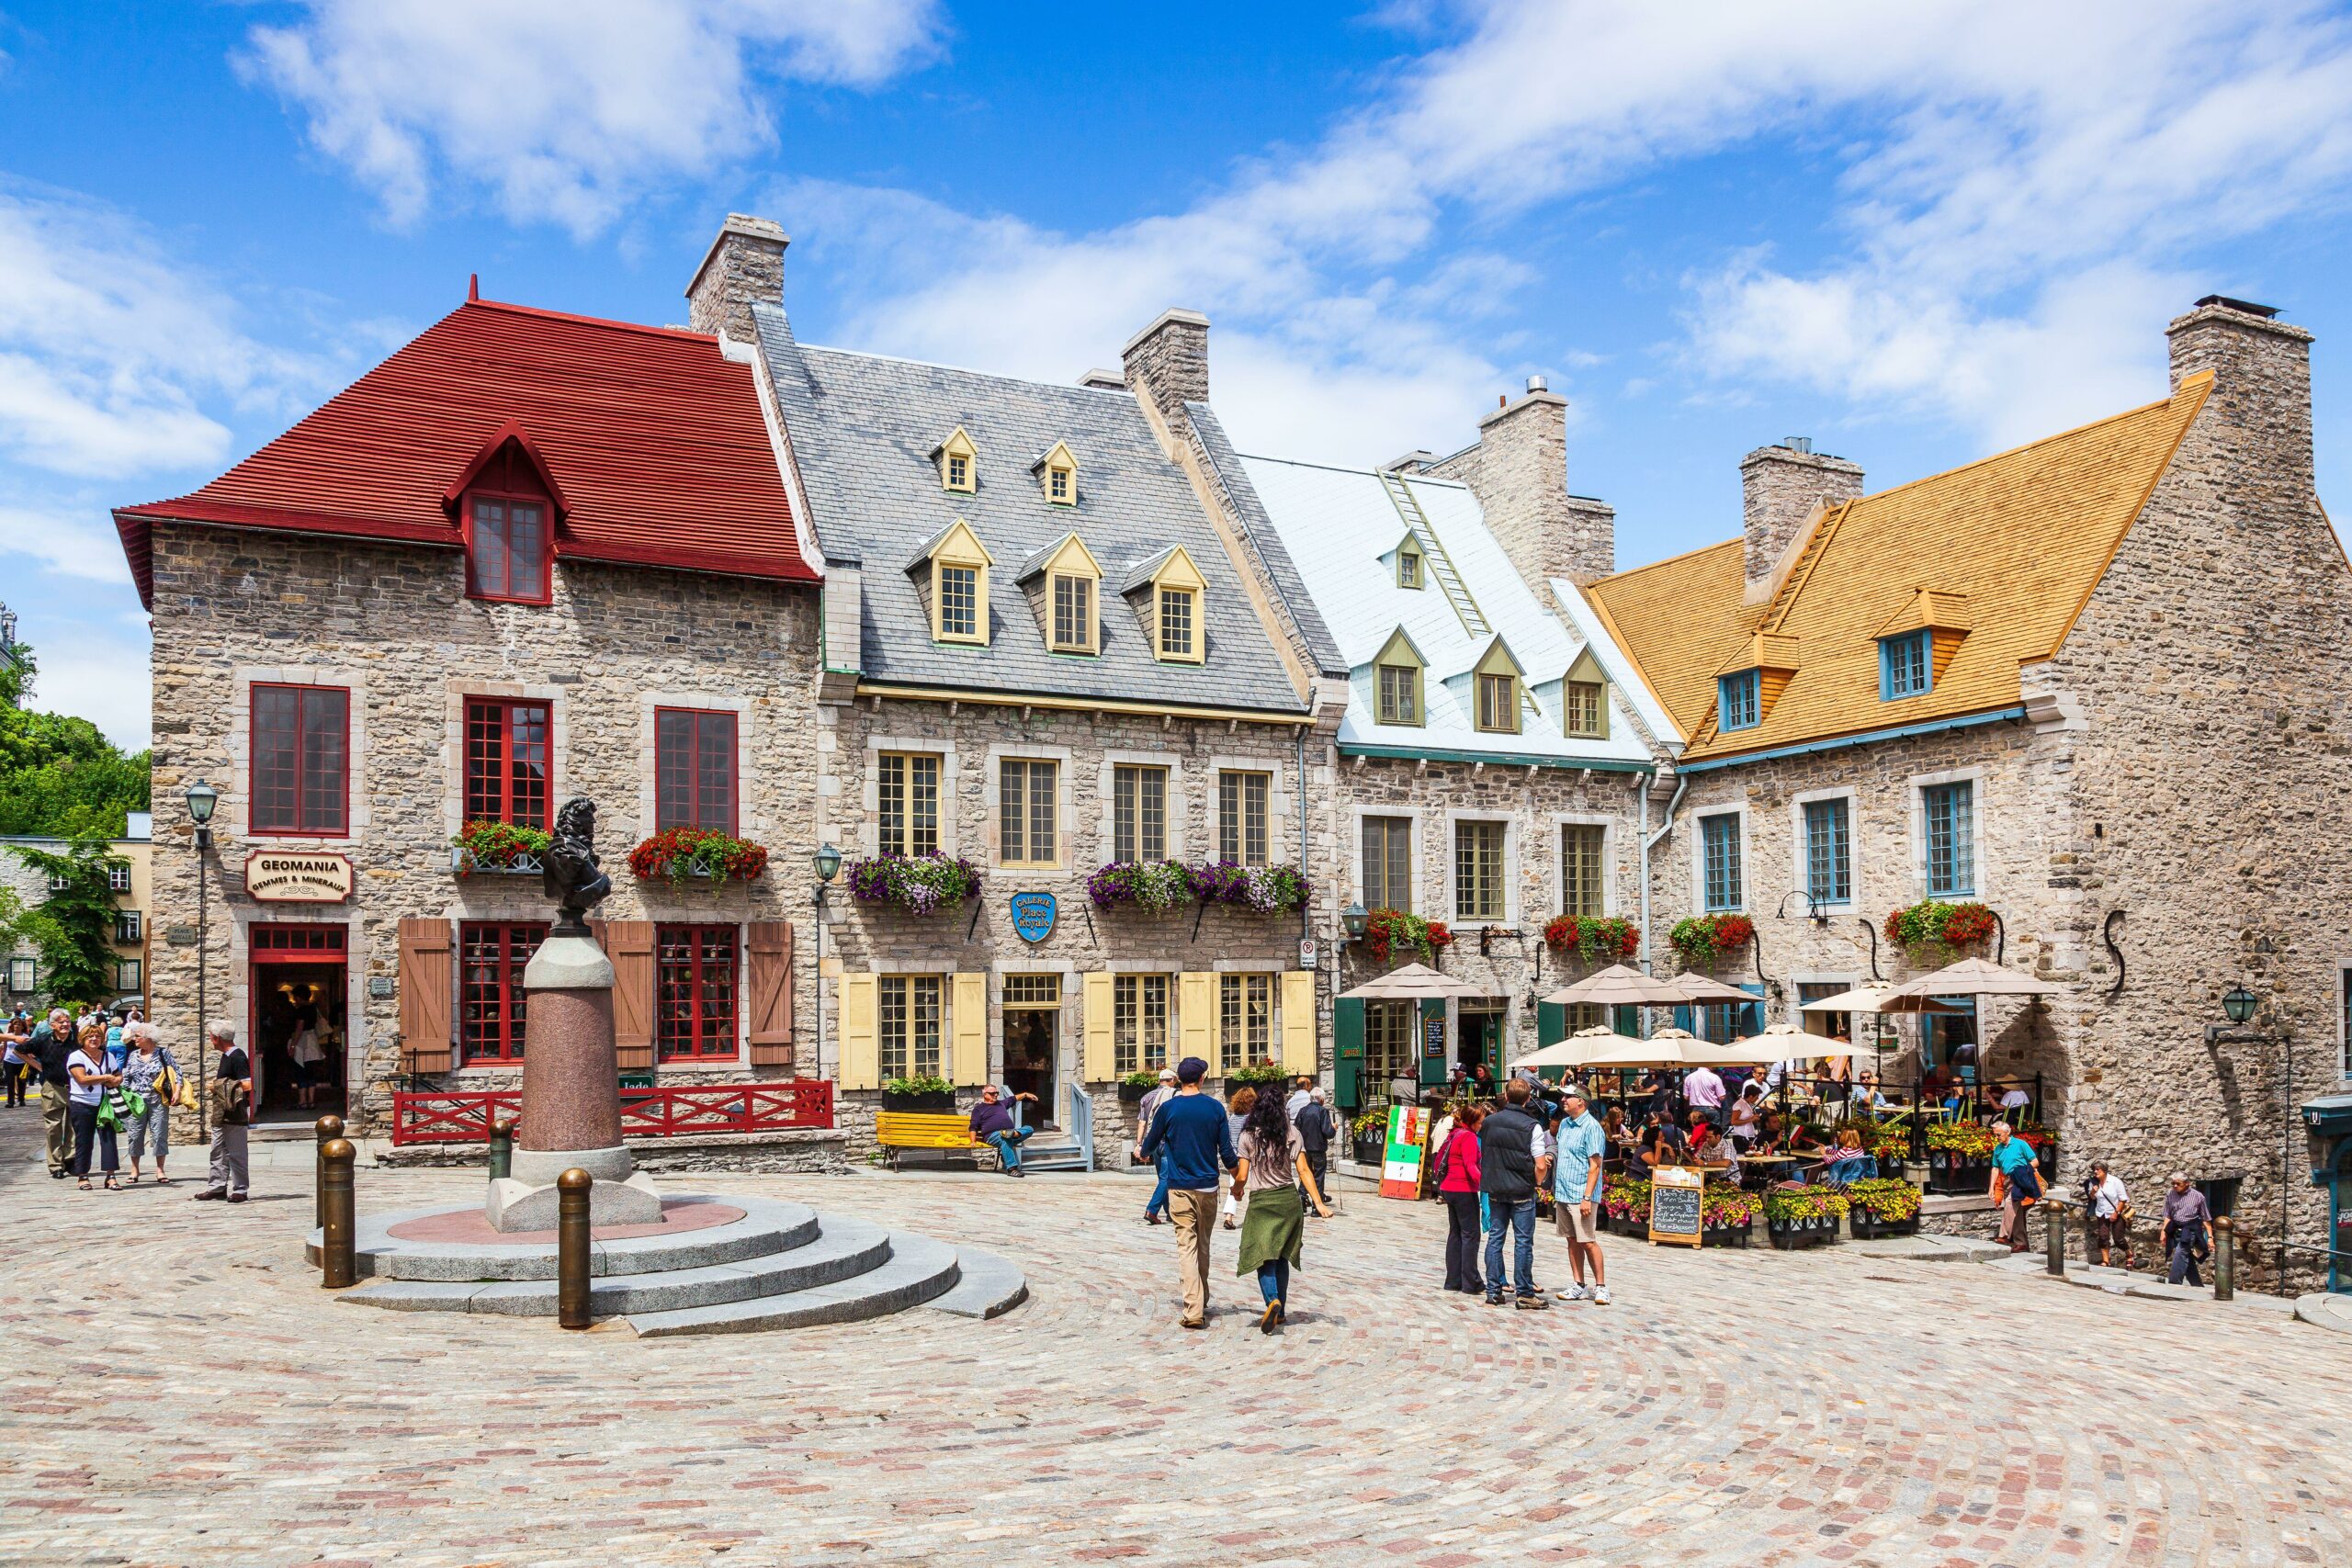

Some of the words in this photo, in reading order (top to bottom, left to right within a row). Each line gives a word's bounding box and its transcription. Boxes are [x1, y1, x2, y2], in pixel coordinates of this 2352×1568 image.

[261, 860, 339, 873] GEOMANIA
[252, 875, 288, 891] GEMMES
[301, 875, 346, 893] MINERAUX
[1016, 897, 1051, 907] GALERIE
[1021, 908, 1046, 917] Place
